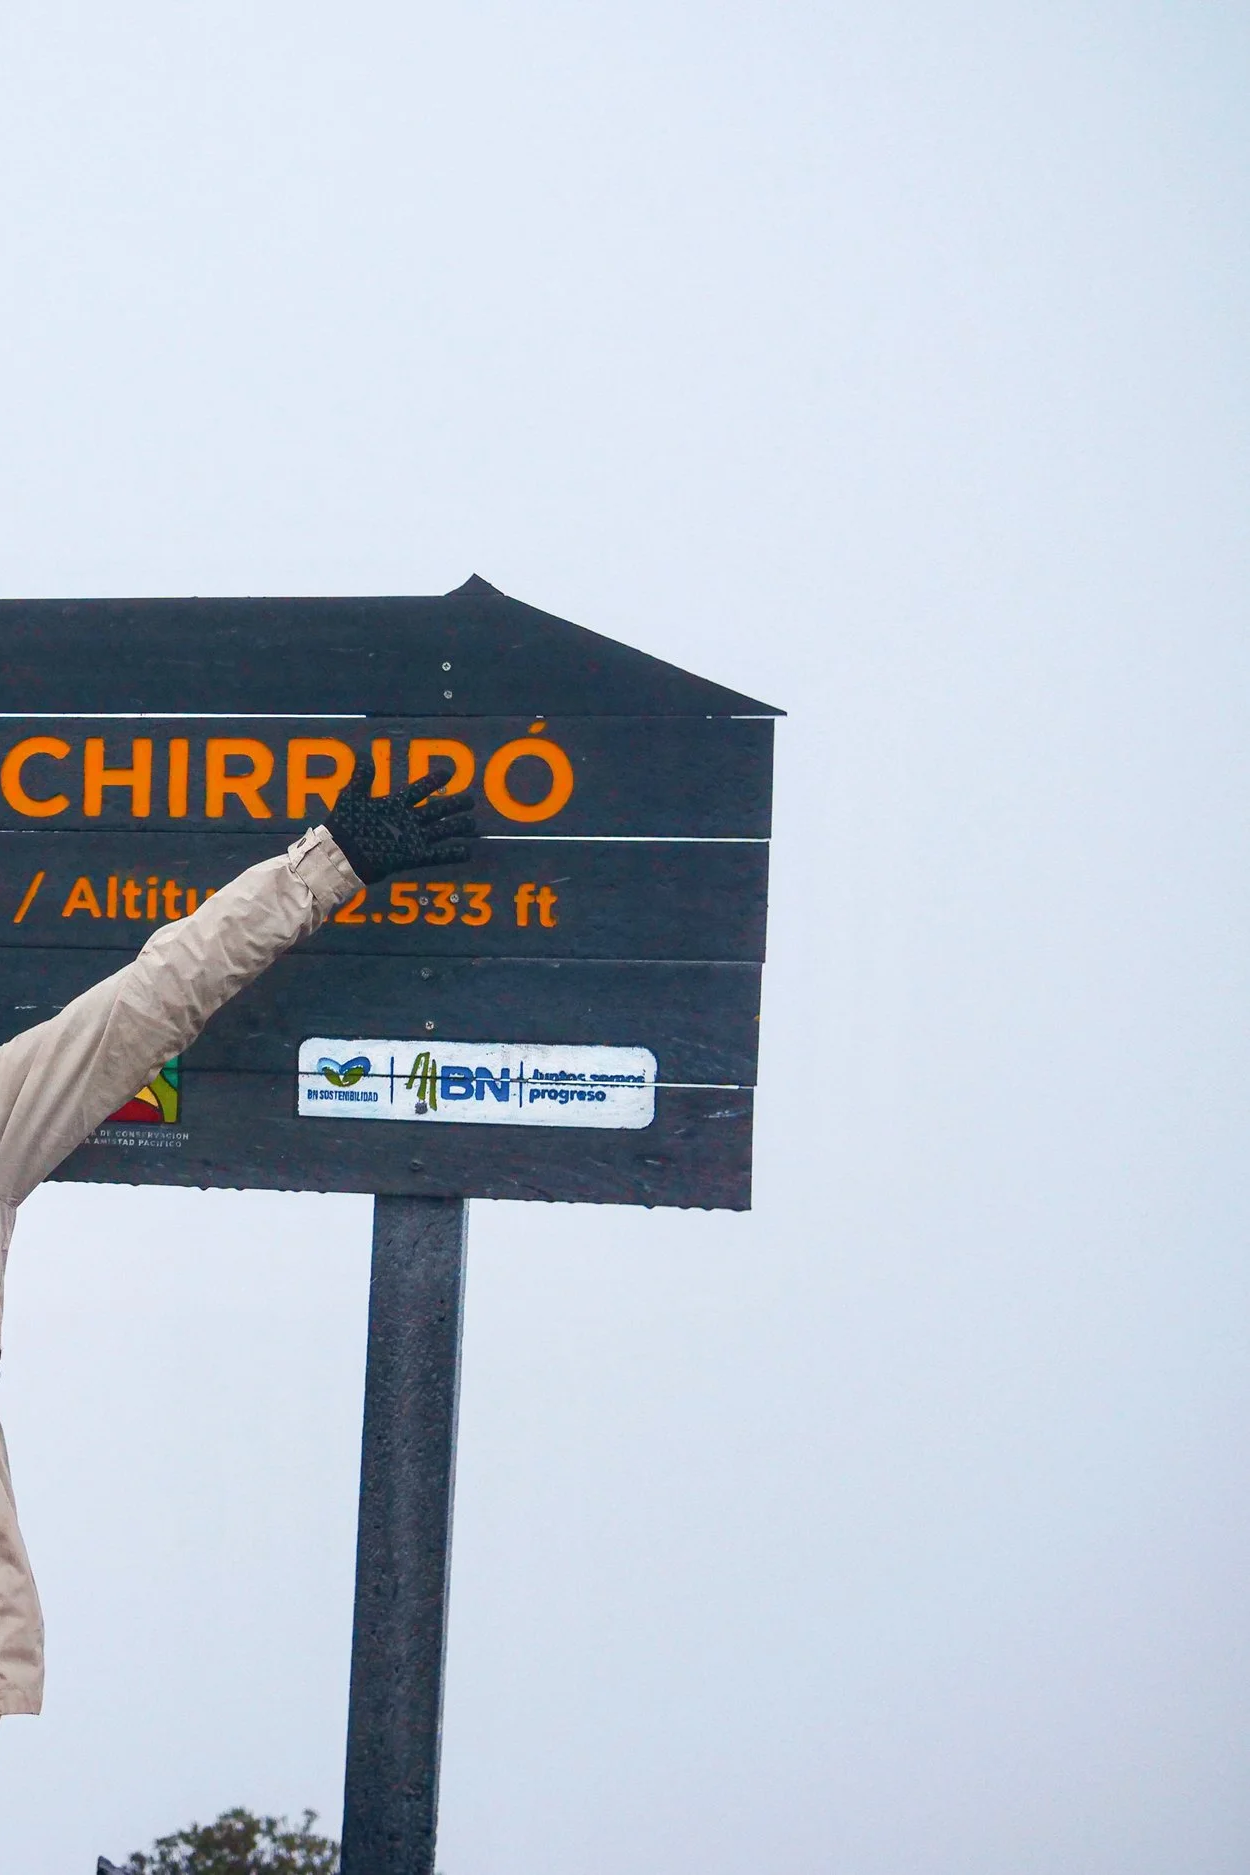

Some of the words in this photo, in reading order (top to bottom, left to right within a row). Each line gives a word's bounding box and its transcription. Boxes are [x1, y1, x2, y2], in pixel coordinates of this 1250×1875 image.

[13, 871, 46, 923] /
[61, 875, 218, 920] Altitu
[323, 881, 493, 926] 2.533
[513, 882, 558, 928] ft
[307, 1089, 318, 1099] BN
[319, 1089, 379, 1102] SOSTENIBILIDAD
[441, 1065, 510, 1102] BN
[528, 1087, 607, 1105] progreso
